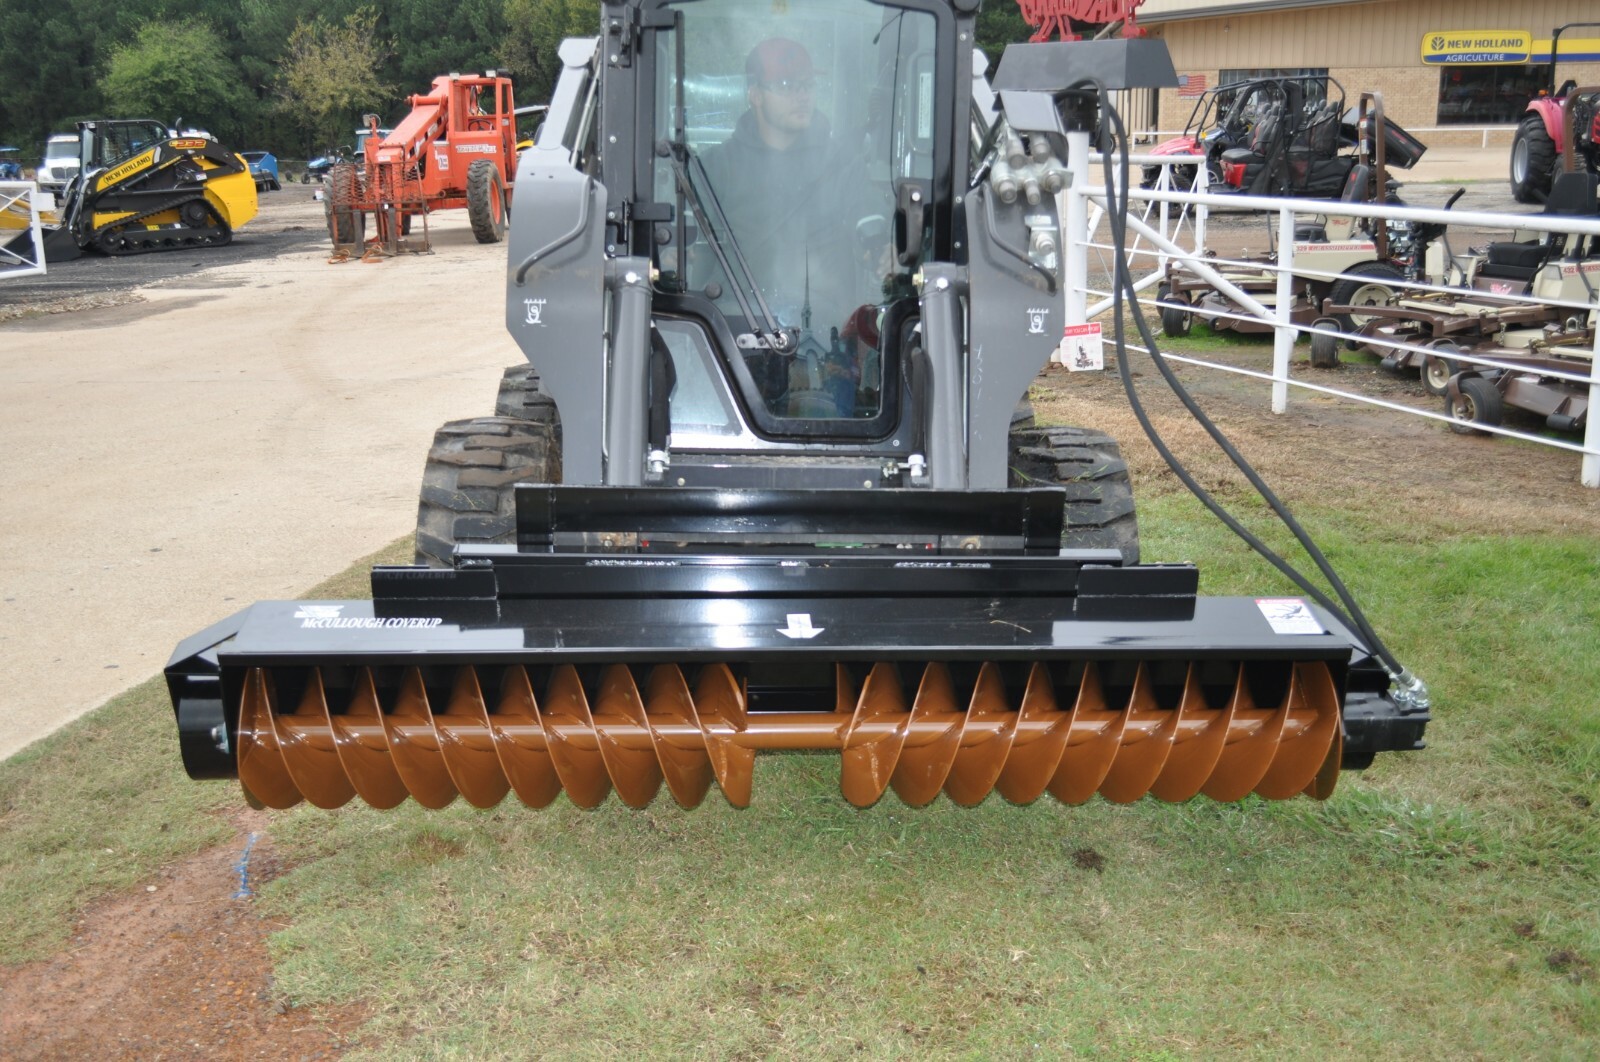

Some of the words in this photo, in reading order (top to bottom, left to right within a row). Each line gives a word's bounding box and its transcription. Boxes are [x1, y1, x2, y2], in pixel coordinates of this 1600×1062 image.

[1447, 39, 1472, 49] NEW
[1474, 38, 1524, 48] HOLLAND
[1445, 53, 1505, 62] AGRICULTURE
[105, 168, 123, 182] NEW
[121, 156, 151, 176] HOLLAND
[301, 617, 385, 628] McCULLOUGH
[385, 617, 443, 628] COVERUP
